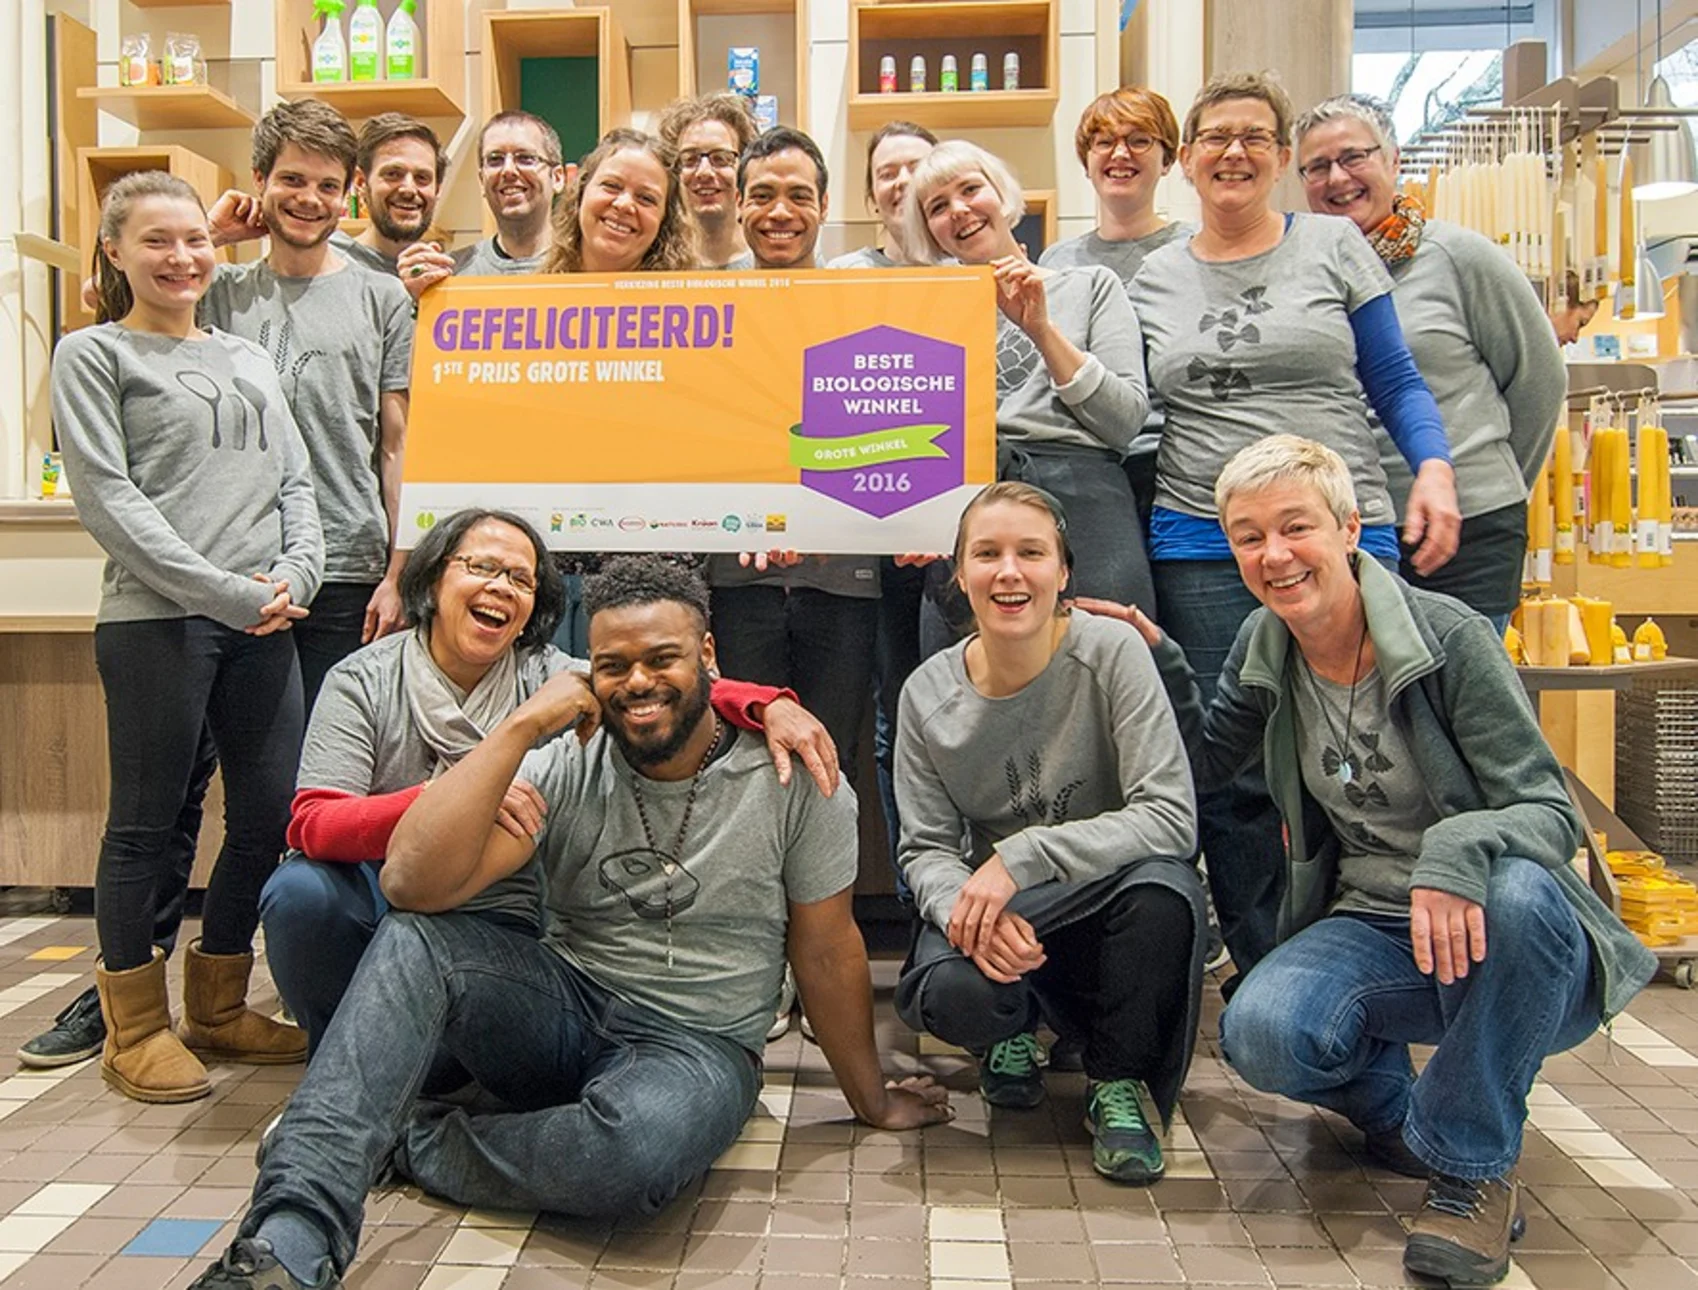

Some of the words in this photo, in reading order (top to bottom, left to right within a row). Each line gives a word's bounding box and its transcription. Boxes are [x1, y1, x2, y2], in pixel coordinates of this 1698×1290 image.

[433, 305, 734, 350] GEFELICITEERD!
[468, 361, 521, 383] PRIJS
[527, 361, 590, 382] GROTE
[595, 360, 665, 382] WINKEL
[853, 354, 914, 369] BESTE
[812, 376, 955, 393] BIOLOGISCHE
[843, 398, 922, 414] WINKEL
[814, 446, 857, 460] GROTE
[860, 439, 908, 456] WINKEL
[853, 472, 912, 493] 2016
